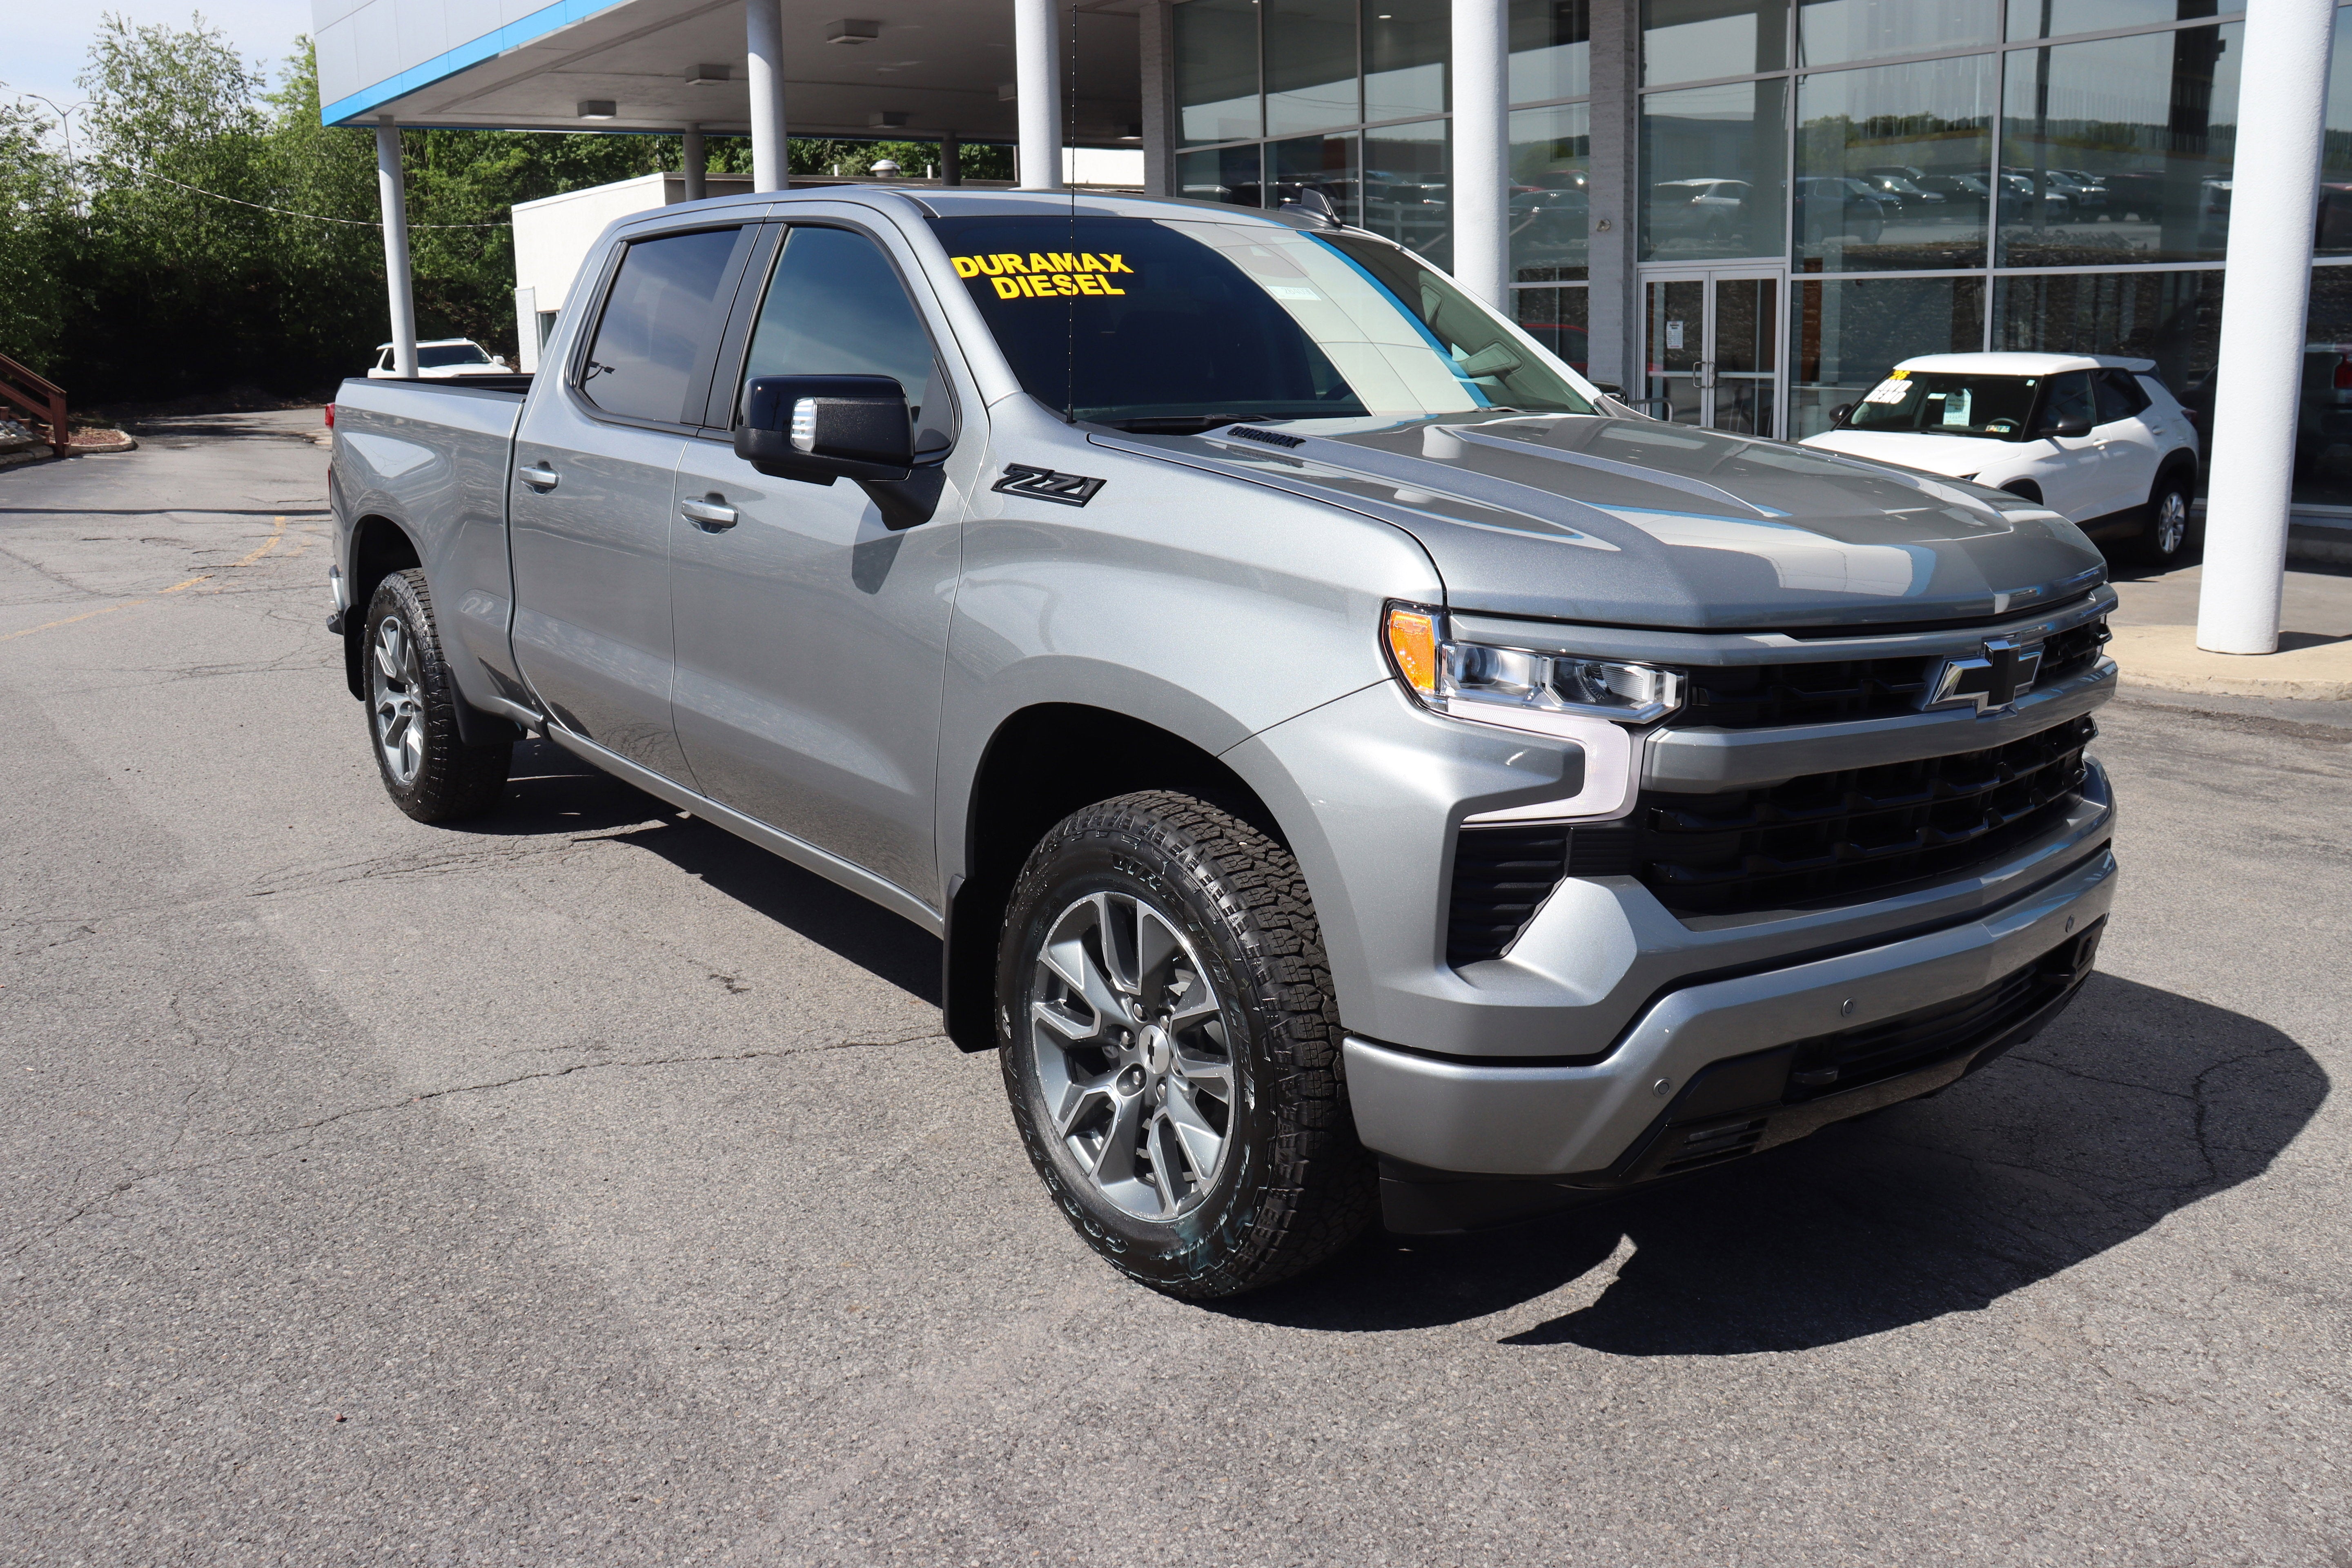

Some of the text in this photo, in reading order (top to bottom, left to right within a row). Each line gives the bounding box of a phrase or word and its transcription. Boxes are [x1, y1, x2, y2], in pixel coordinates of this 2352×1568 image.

[950, 252, 1134, 278] DURAMAX
[990, 274, 1126, 299] DIESEL
[1863, 390, 1907, 404] DEMO
[1875, 379, 1913, 392] AWD
[1227, 426, 1307, 448] DURAMAX
[990, 462, 1107, 508] Z71
